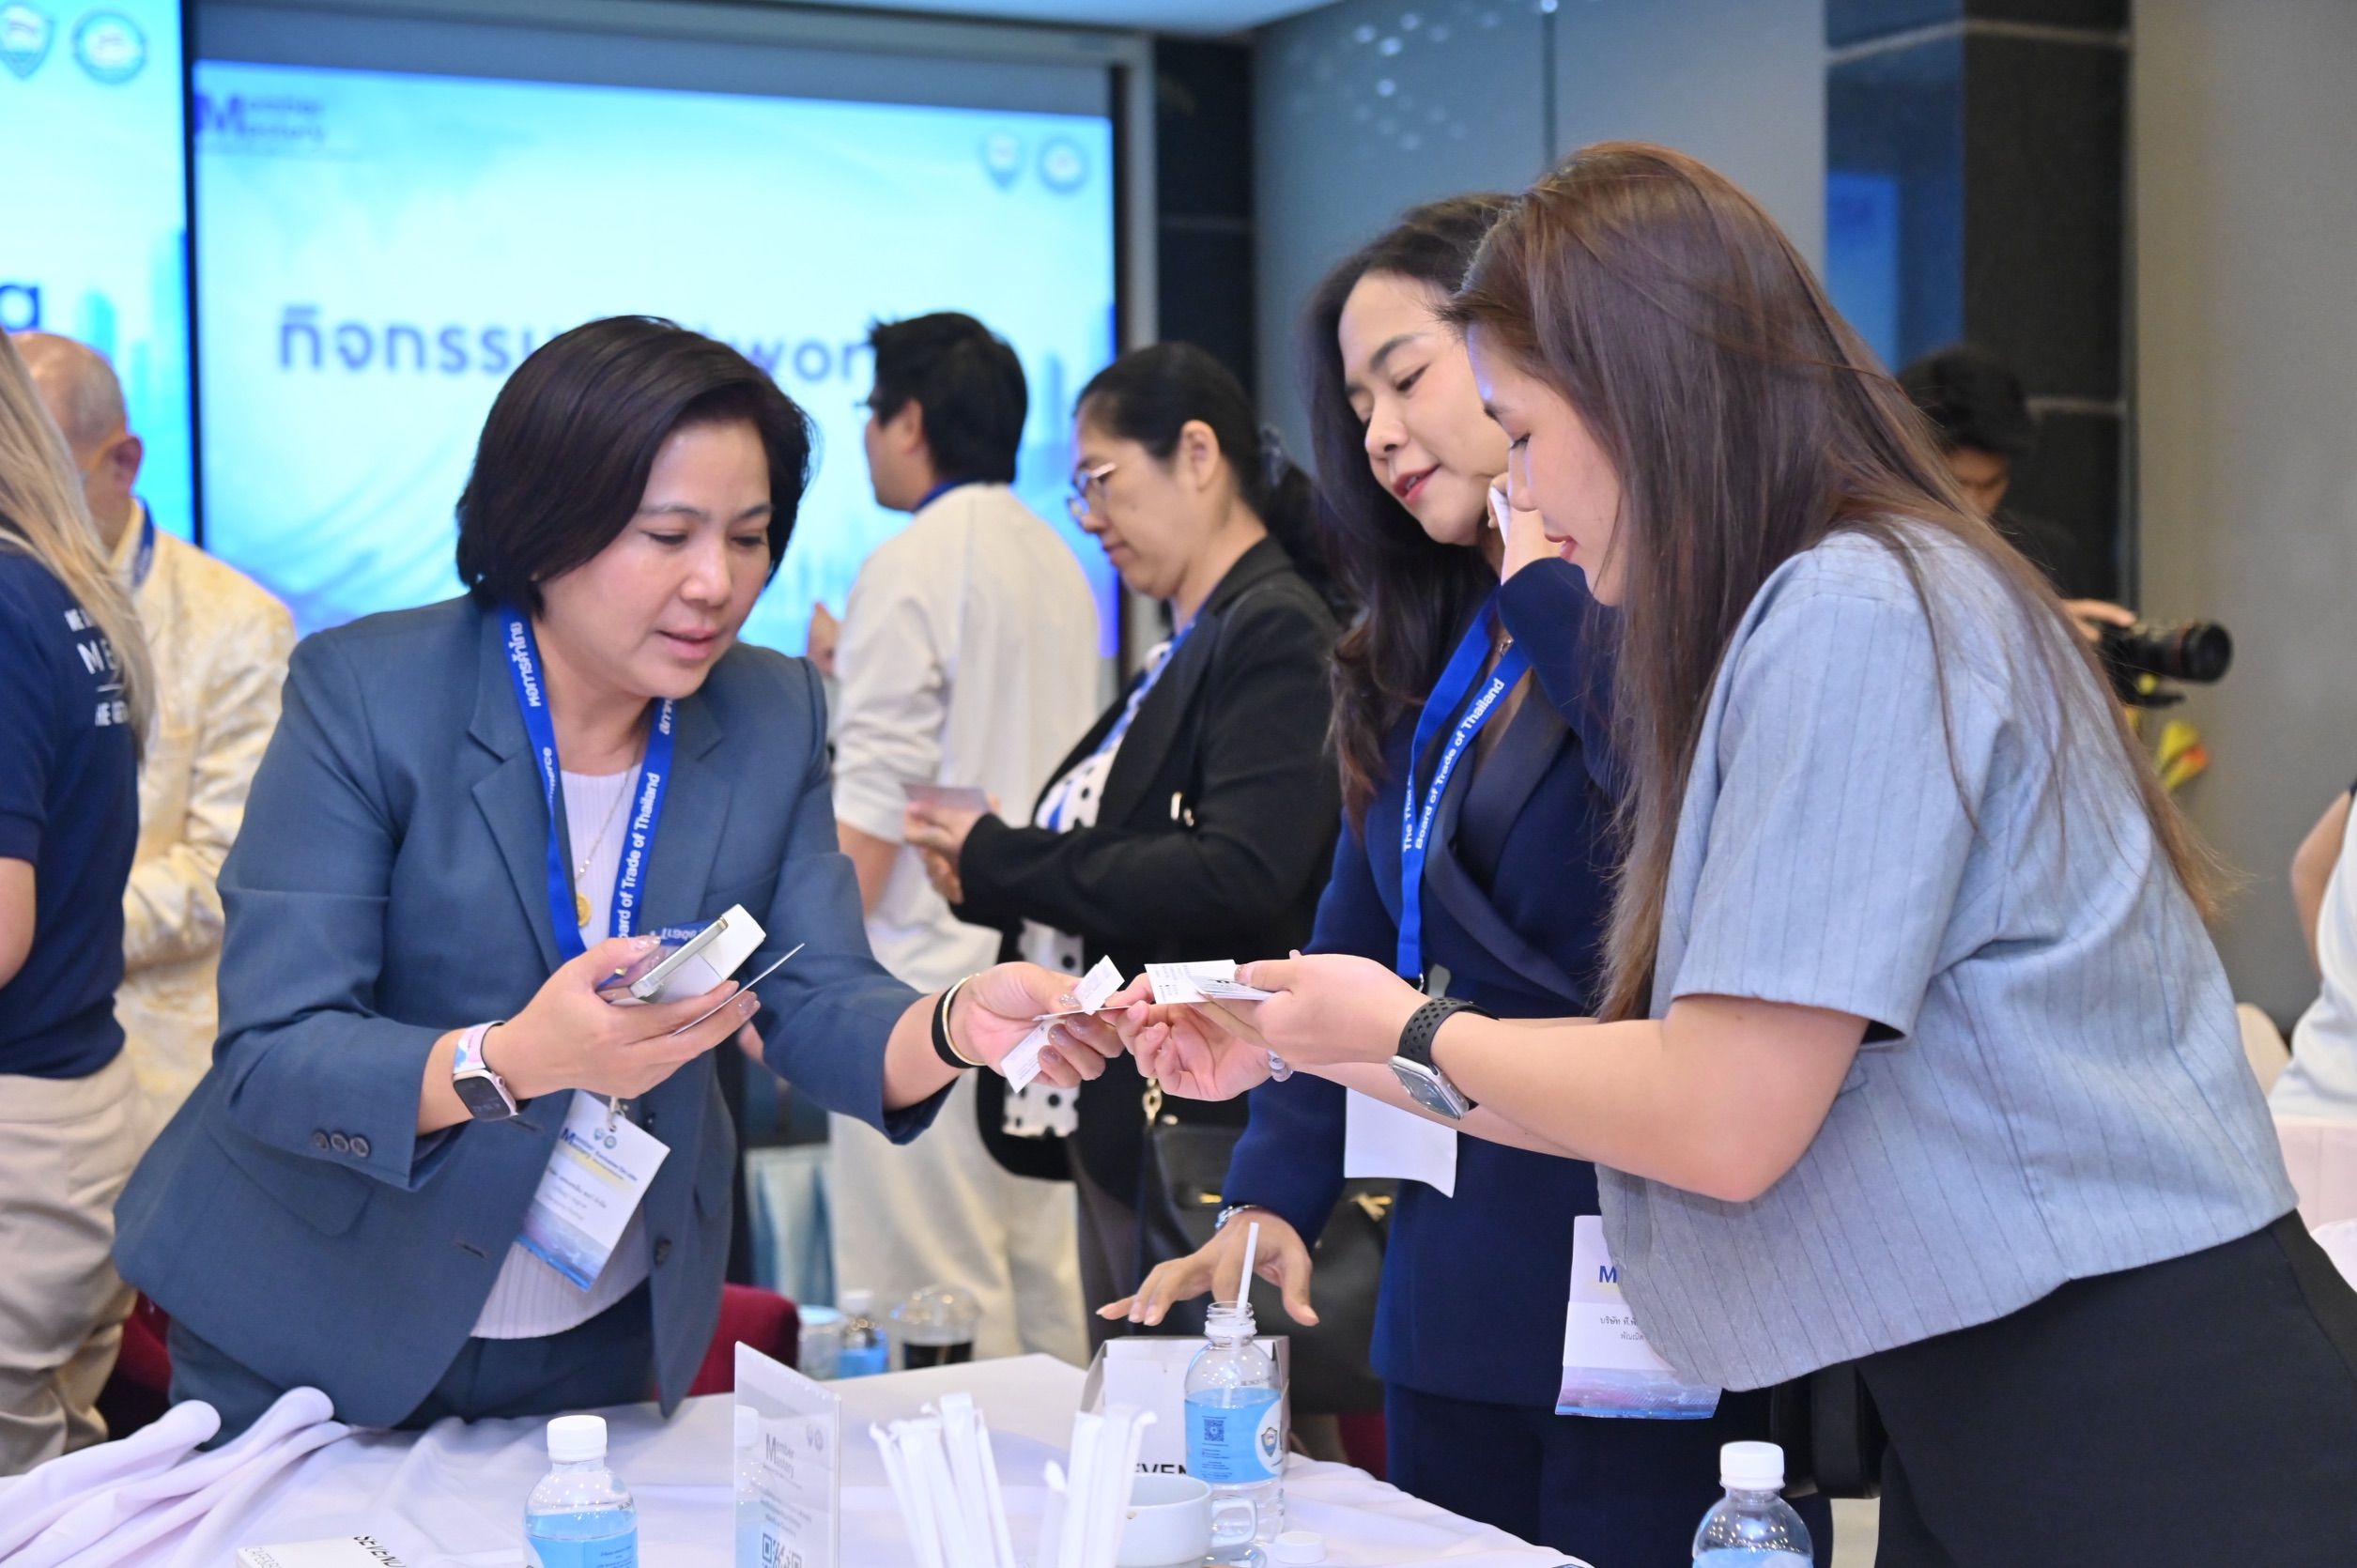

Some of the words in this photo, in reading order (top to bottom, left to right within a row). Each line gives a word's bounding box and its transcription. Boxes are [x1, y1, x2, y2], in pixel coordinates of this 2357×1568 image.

[1415, 805, 1433, 850] Board
[1429, 787, 1439, 804] of
[1434, 747, 1457, 786] Trade
[1454, 730, 1465, 747] of
[1460, 676, 1505, 730] Thailand
[633, 771, 660, 830] Thailand
[631, 832, 646, 849] of
[1403, 823, 1412, 853] The
[621, 849, 642, 889] Trade
[619, 890, 634, 908] of
[1135, 1463, 1187, 1474] VE
